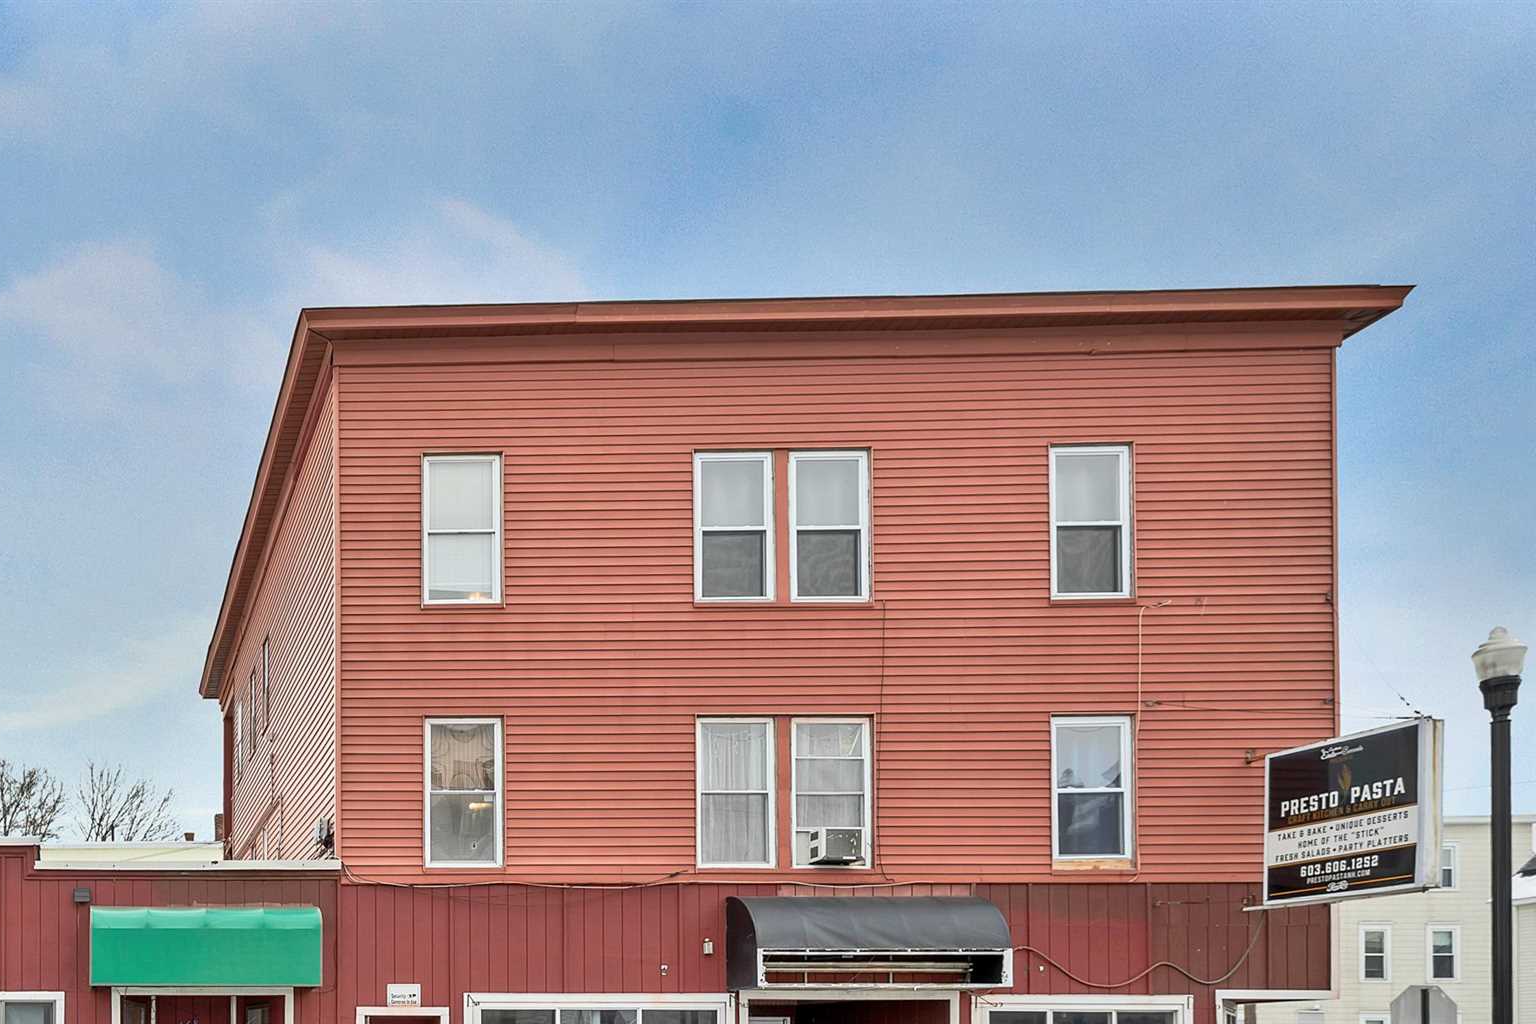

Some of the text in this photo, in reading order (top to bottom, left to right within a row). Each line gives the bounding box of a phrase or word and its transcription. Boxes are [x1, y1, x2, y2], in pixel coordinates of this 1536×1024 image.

[1281, 777, 1406, 818] PRESTO PASTA
[1277, 830, 1297, 841] TAKE
[1307, 826, 1327, 837] BAKE
[1335, 819, 1364, 832] UNIQUE
[1366, 811, 1408, 825] DESSERTS
[1297, 826, 1384, 849] HOME OF THE "STICK"
[1275, 834, 1409, 863] FRESH SALADS PARTY PLATTERS
[1300, 854, 1379, 878] 603.606.1252
